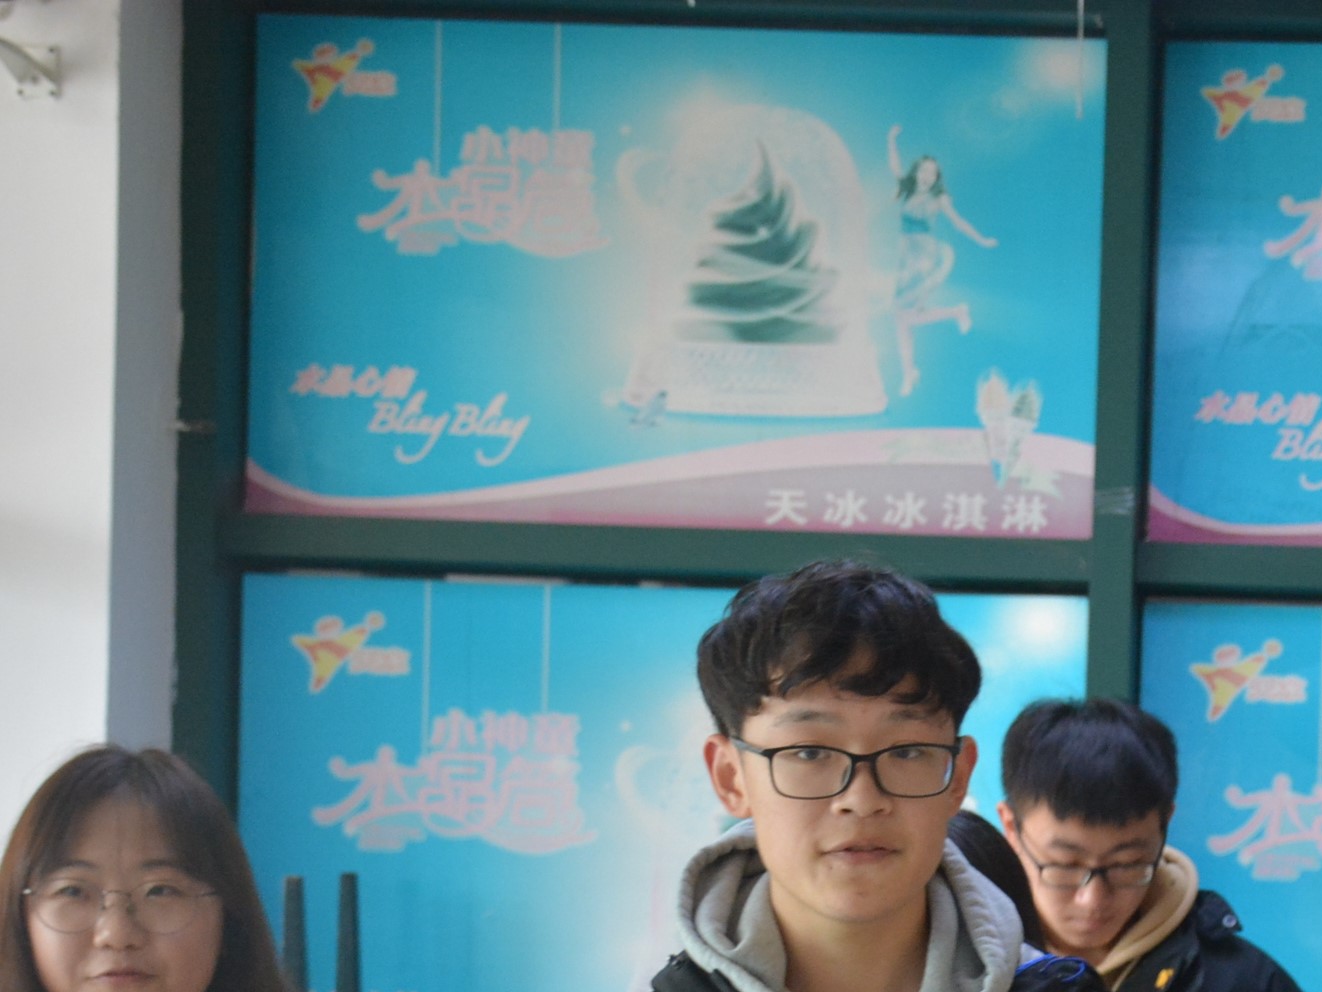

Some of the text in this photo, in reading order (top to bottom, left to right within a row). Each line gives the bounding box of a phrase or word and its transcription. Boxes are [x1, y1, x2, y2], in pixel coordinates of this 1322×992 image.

[369, 391, 530, 467] Bling Bling
[763, 490, 1047, 533] 天冰冰淇淋
